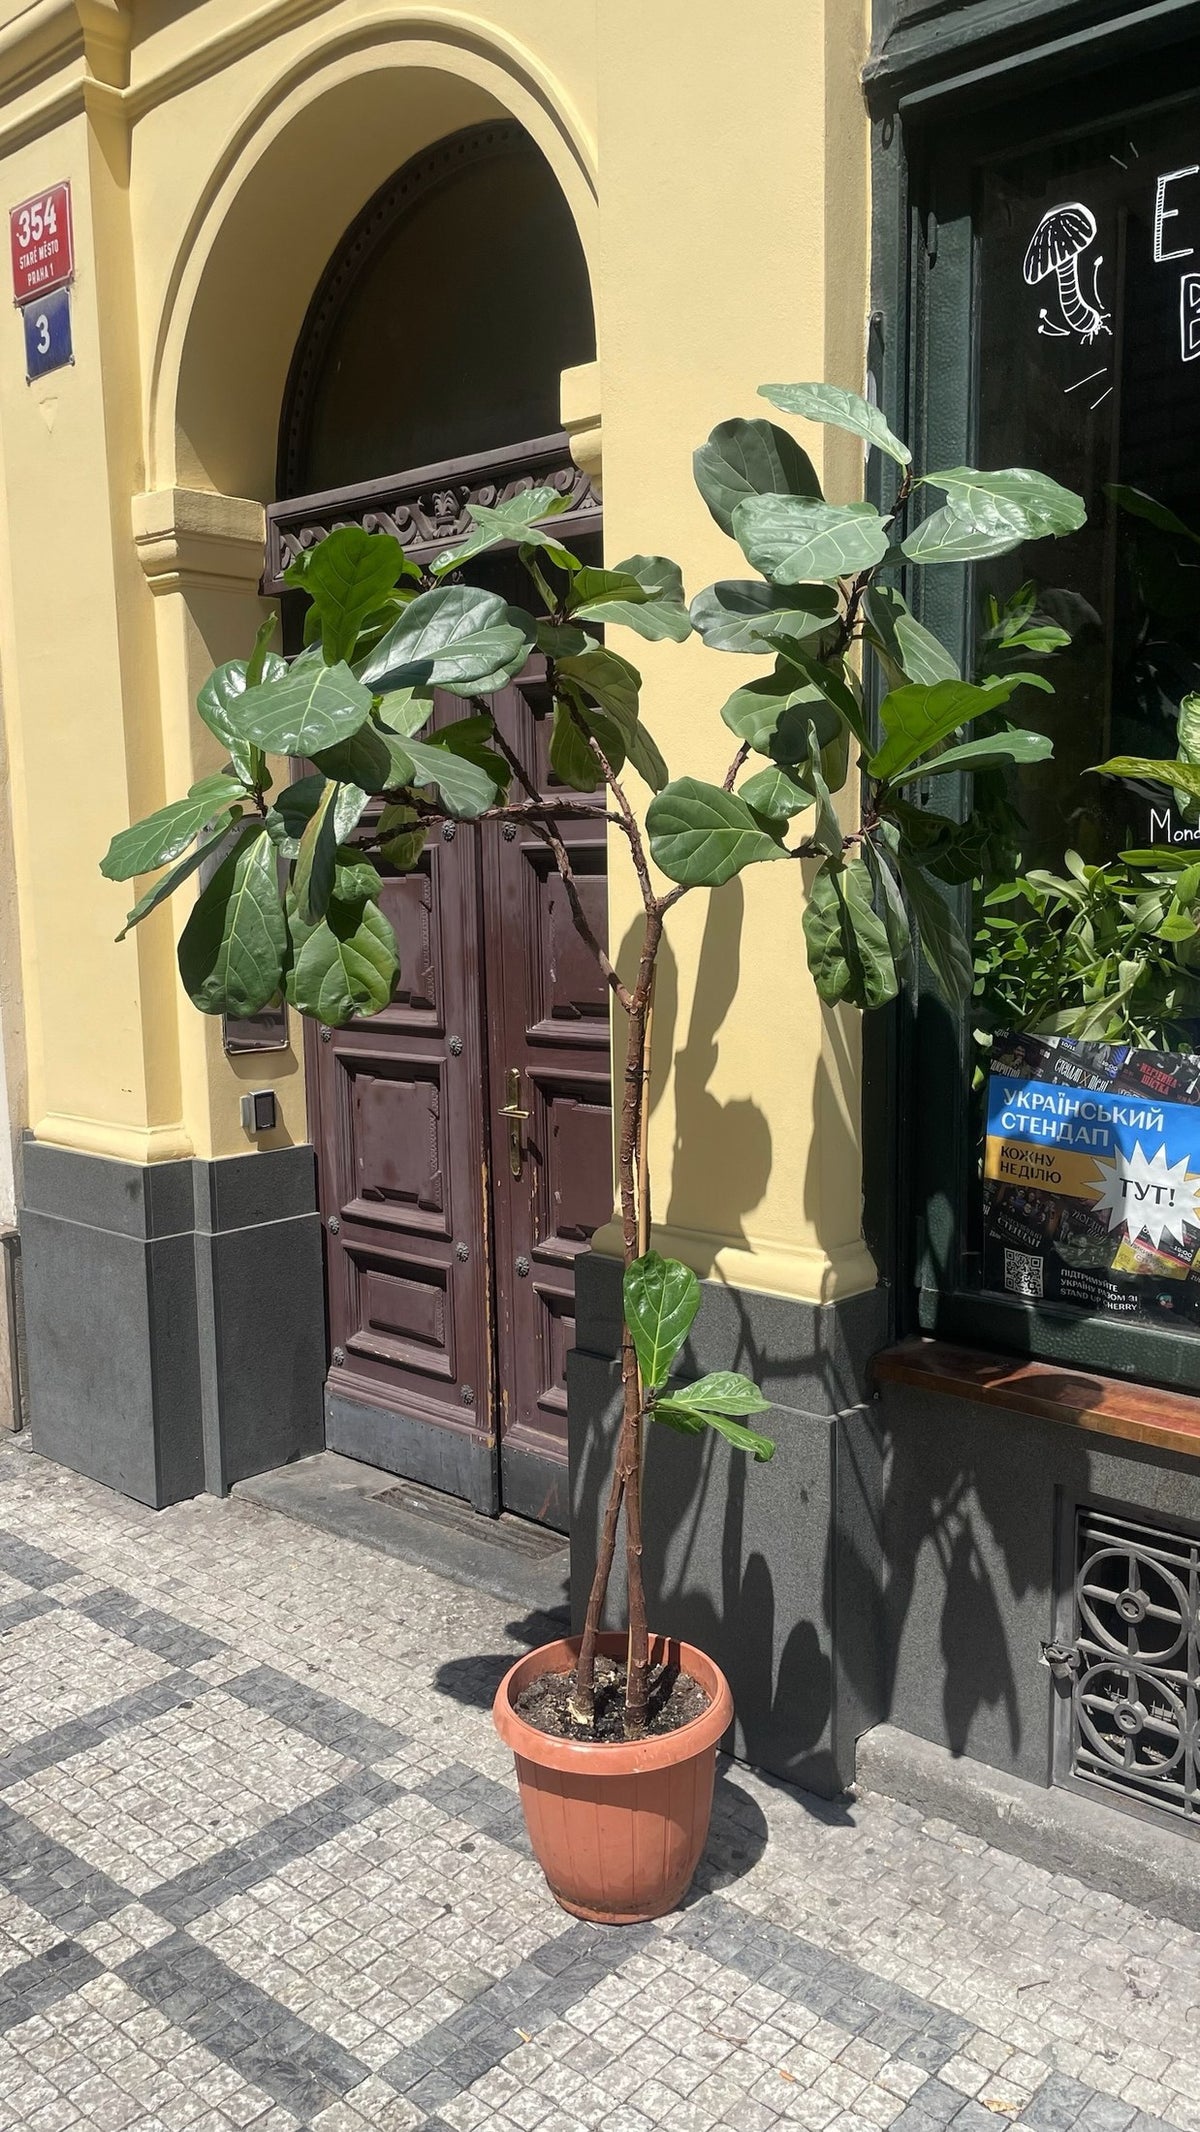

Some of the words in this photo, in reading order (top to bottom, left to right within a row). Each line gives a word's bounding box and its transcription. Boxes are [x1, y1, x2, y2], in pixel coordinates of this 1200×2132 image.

[18, 196, 57, 248] 354
[1154, 165, 1200, 262] E
[20, 245, 38, 270] STARÉ
[39, 239, 59, 261] MĚSTO
[27, 265, 49, 287] PRAHA
[50, 262, 54, 277] 1
[36, 314, 50, 354] 3
[1003, 1088, 1164, 1132] УКРАЇНСЬКИЙ
[1001, 1112, 1109, 1147] СТЕНДАП
[1001, 1146, 1056, 1167] КОЖНУ
[1000, 1162, 1062, 1184] НЕДІЛЮ
[1119, 1177, 1175, 1207] ТУТ!
[1061, 1269, 1118, 1292] ПІДТРИМУЙТЕ
[1061, 1278, 1096, 1293] УКРАЇНУ
[1097, 1288, 1126, 1302] РАЗОМ
[1060, 1288, 1089, 1300] STAND
[1102, 1299, 1138, 1311] CHERRY
